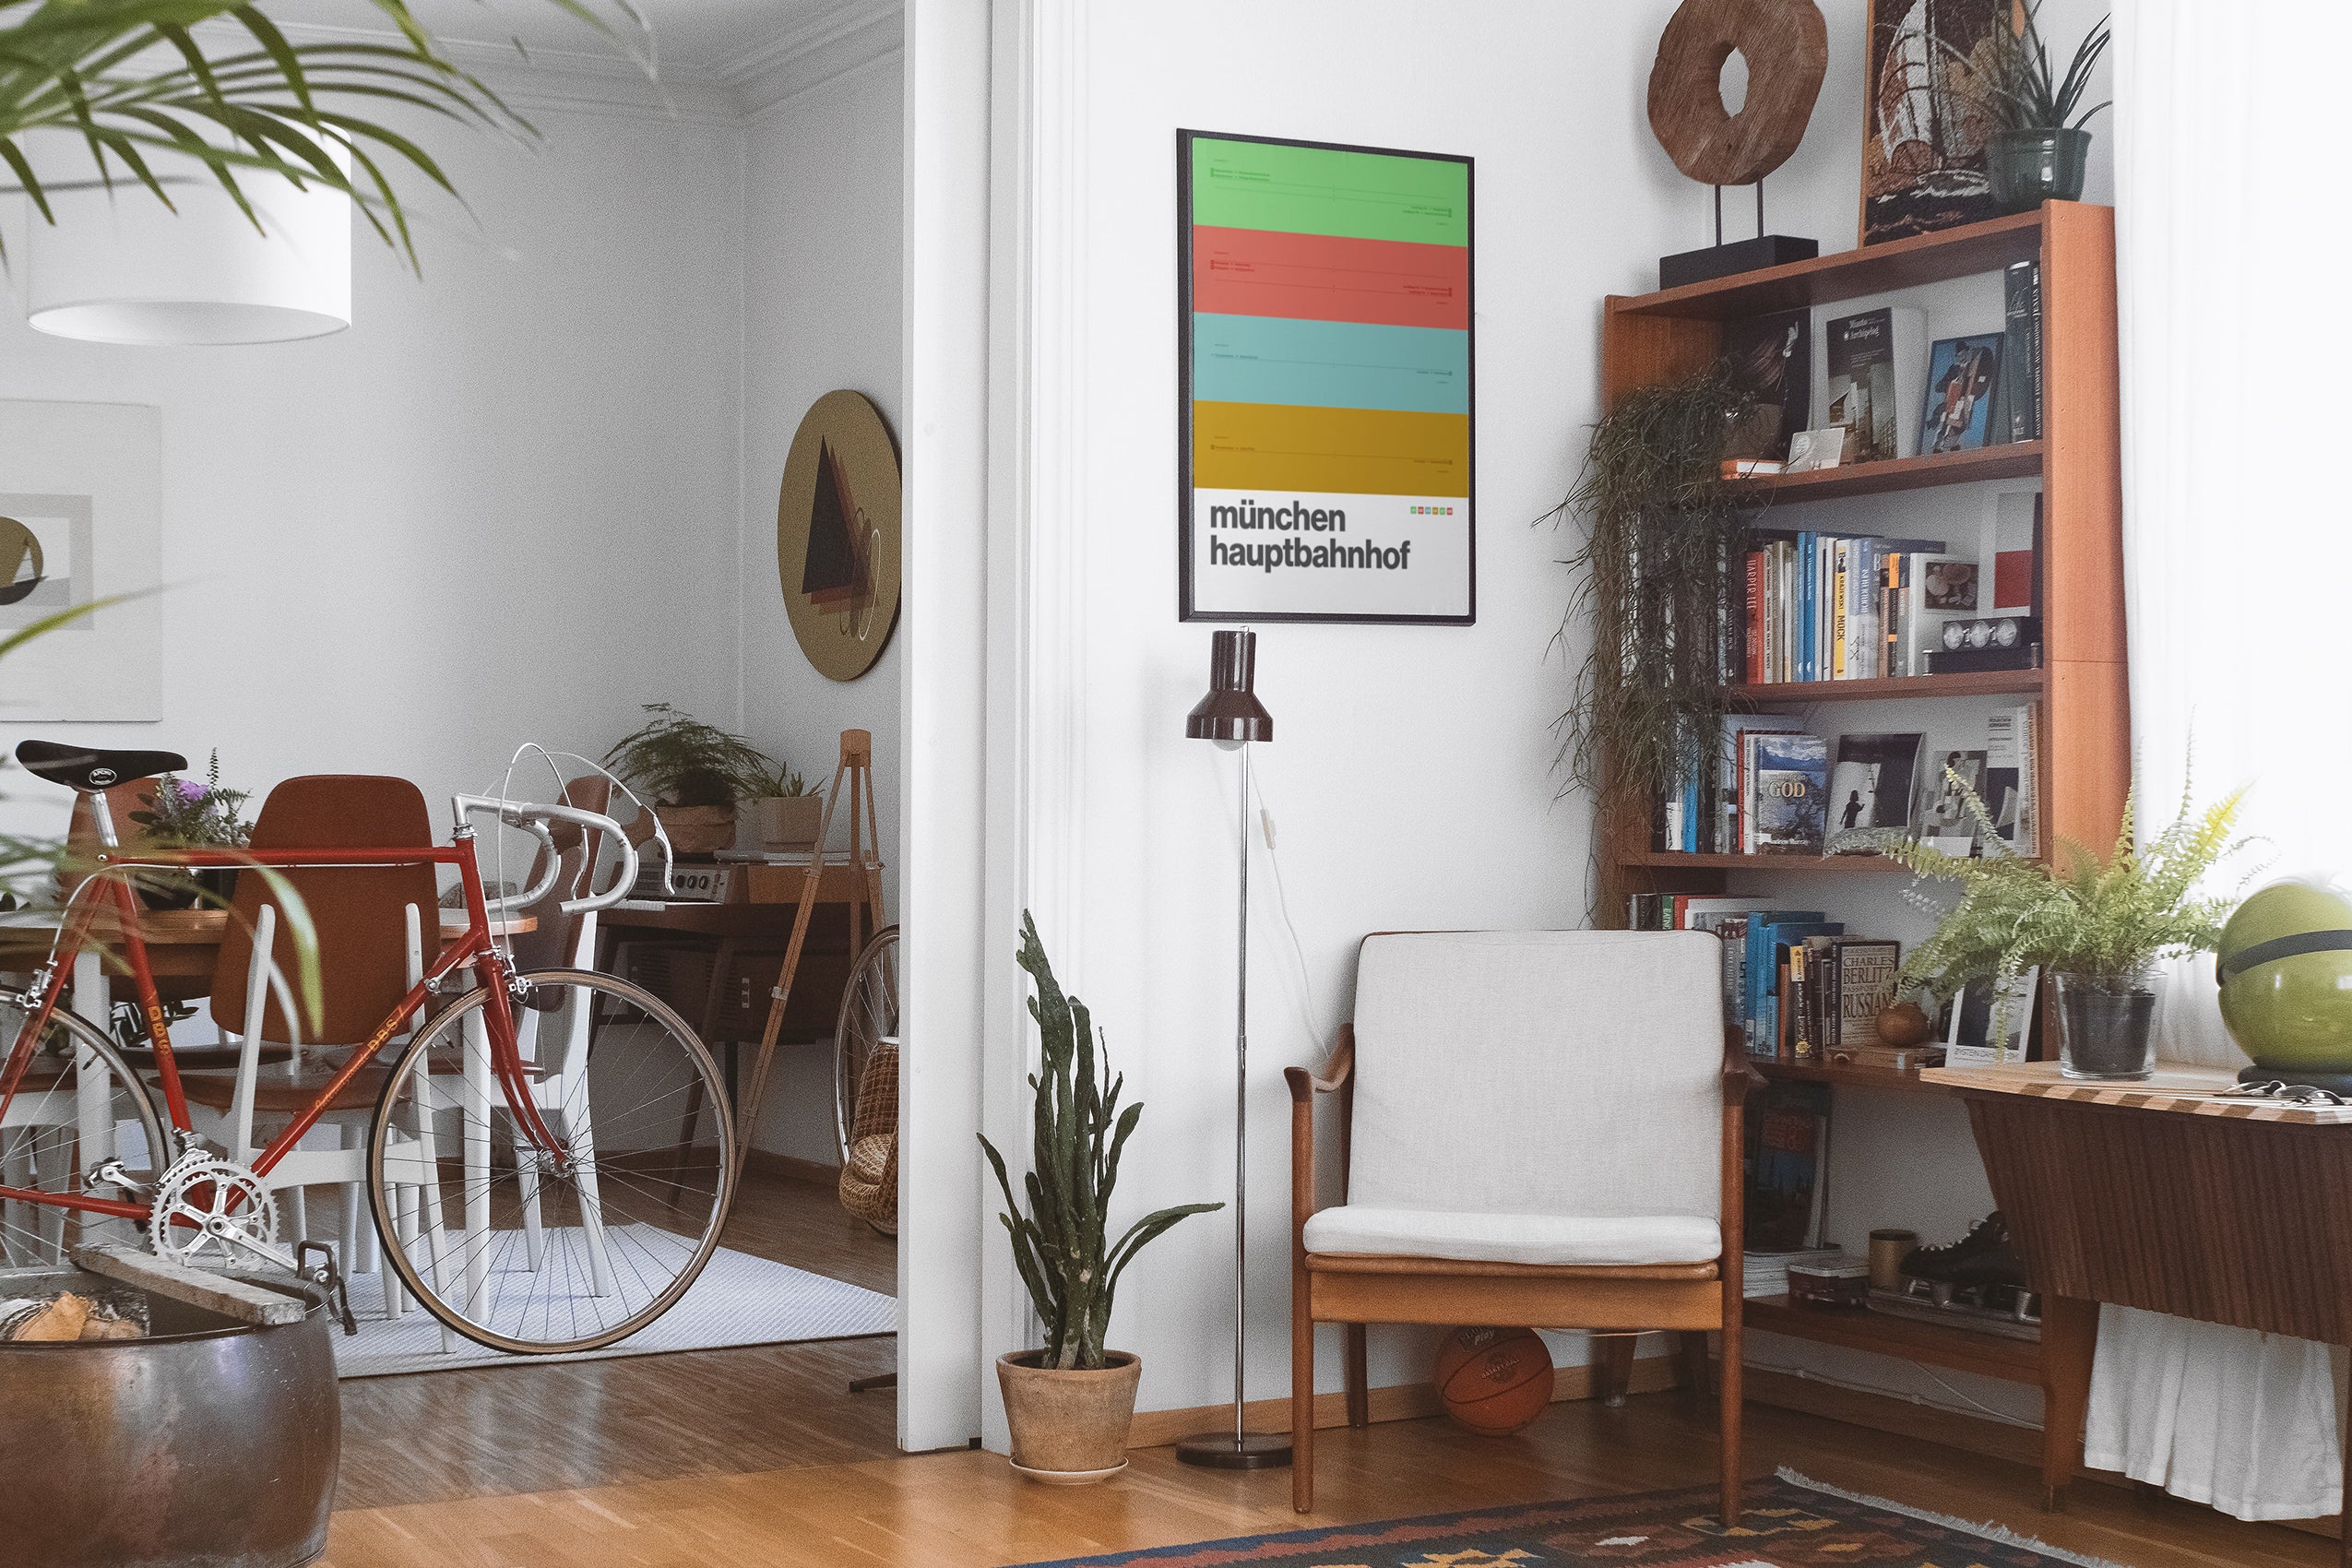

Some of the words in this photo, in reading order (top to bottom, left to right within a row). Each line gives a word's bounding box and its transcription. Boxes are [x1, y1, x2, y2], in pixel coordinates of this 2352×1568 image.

[1210, 499, 1346, 531] münchen
[1210, 535, 1410, 573] hauptbahnhof
[1746, 559, 1757, 594] HARPER
[1746, 596, 1757, 610] LEE
[1836, 614, 1845, 641] MOCK
[1768, 781, 1806, 799] GOD
[1843, 956, 1895, 967] CHARLES
[1843, 967, 1894, 984] BERLITZ
[1843, 984, 1878, 992] PASSPORT
[1843, 992, 1893, 1018] RUSSIAN
[148, 1005, 171, 1056] DBS
[367, 1017, 399, 1051] DBS
